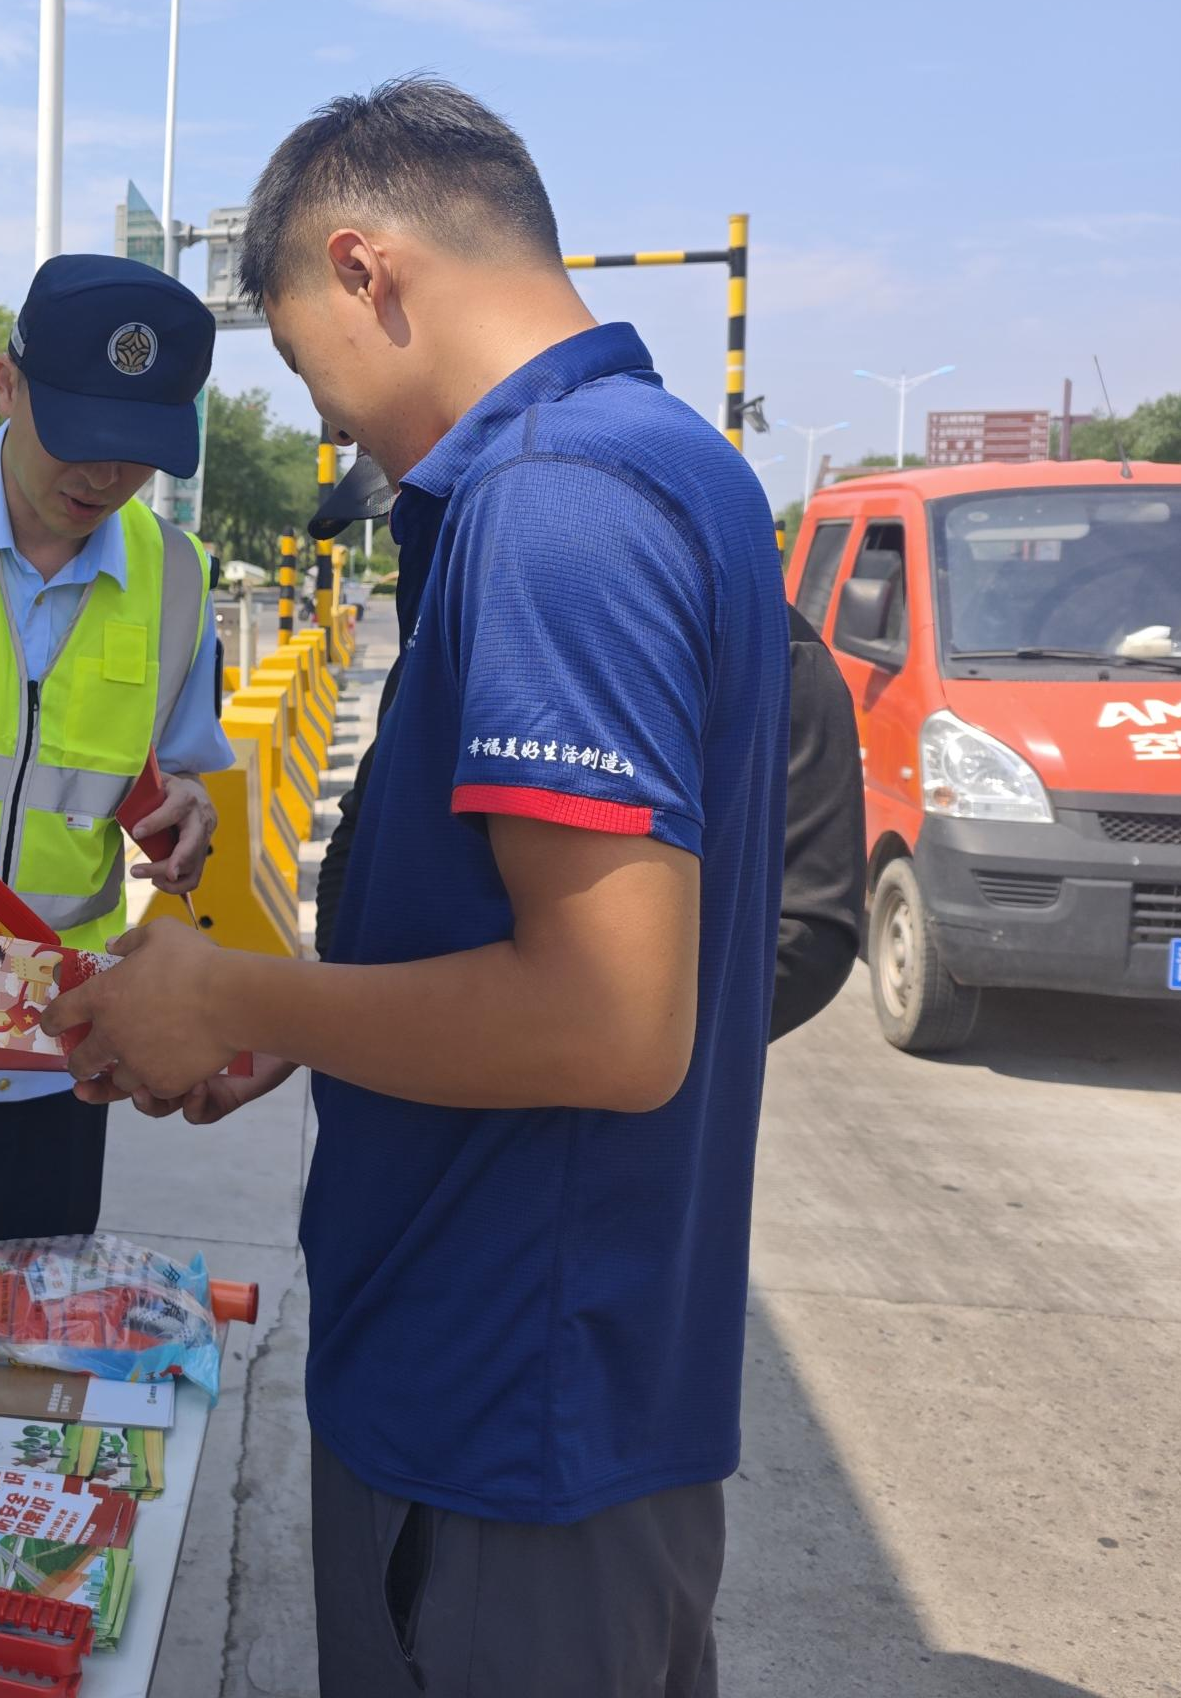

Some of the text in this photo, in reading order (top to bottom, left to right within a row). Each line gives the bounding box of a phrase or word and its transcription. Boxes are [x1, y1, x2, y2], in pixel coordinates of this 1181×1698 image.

[467, 736, 635, 777] 幸福美好生活创造者
[1128, 730, 1181, 761] 空
